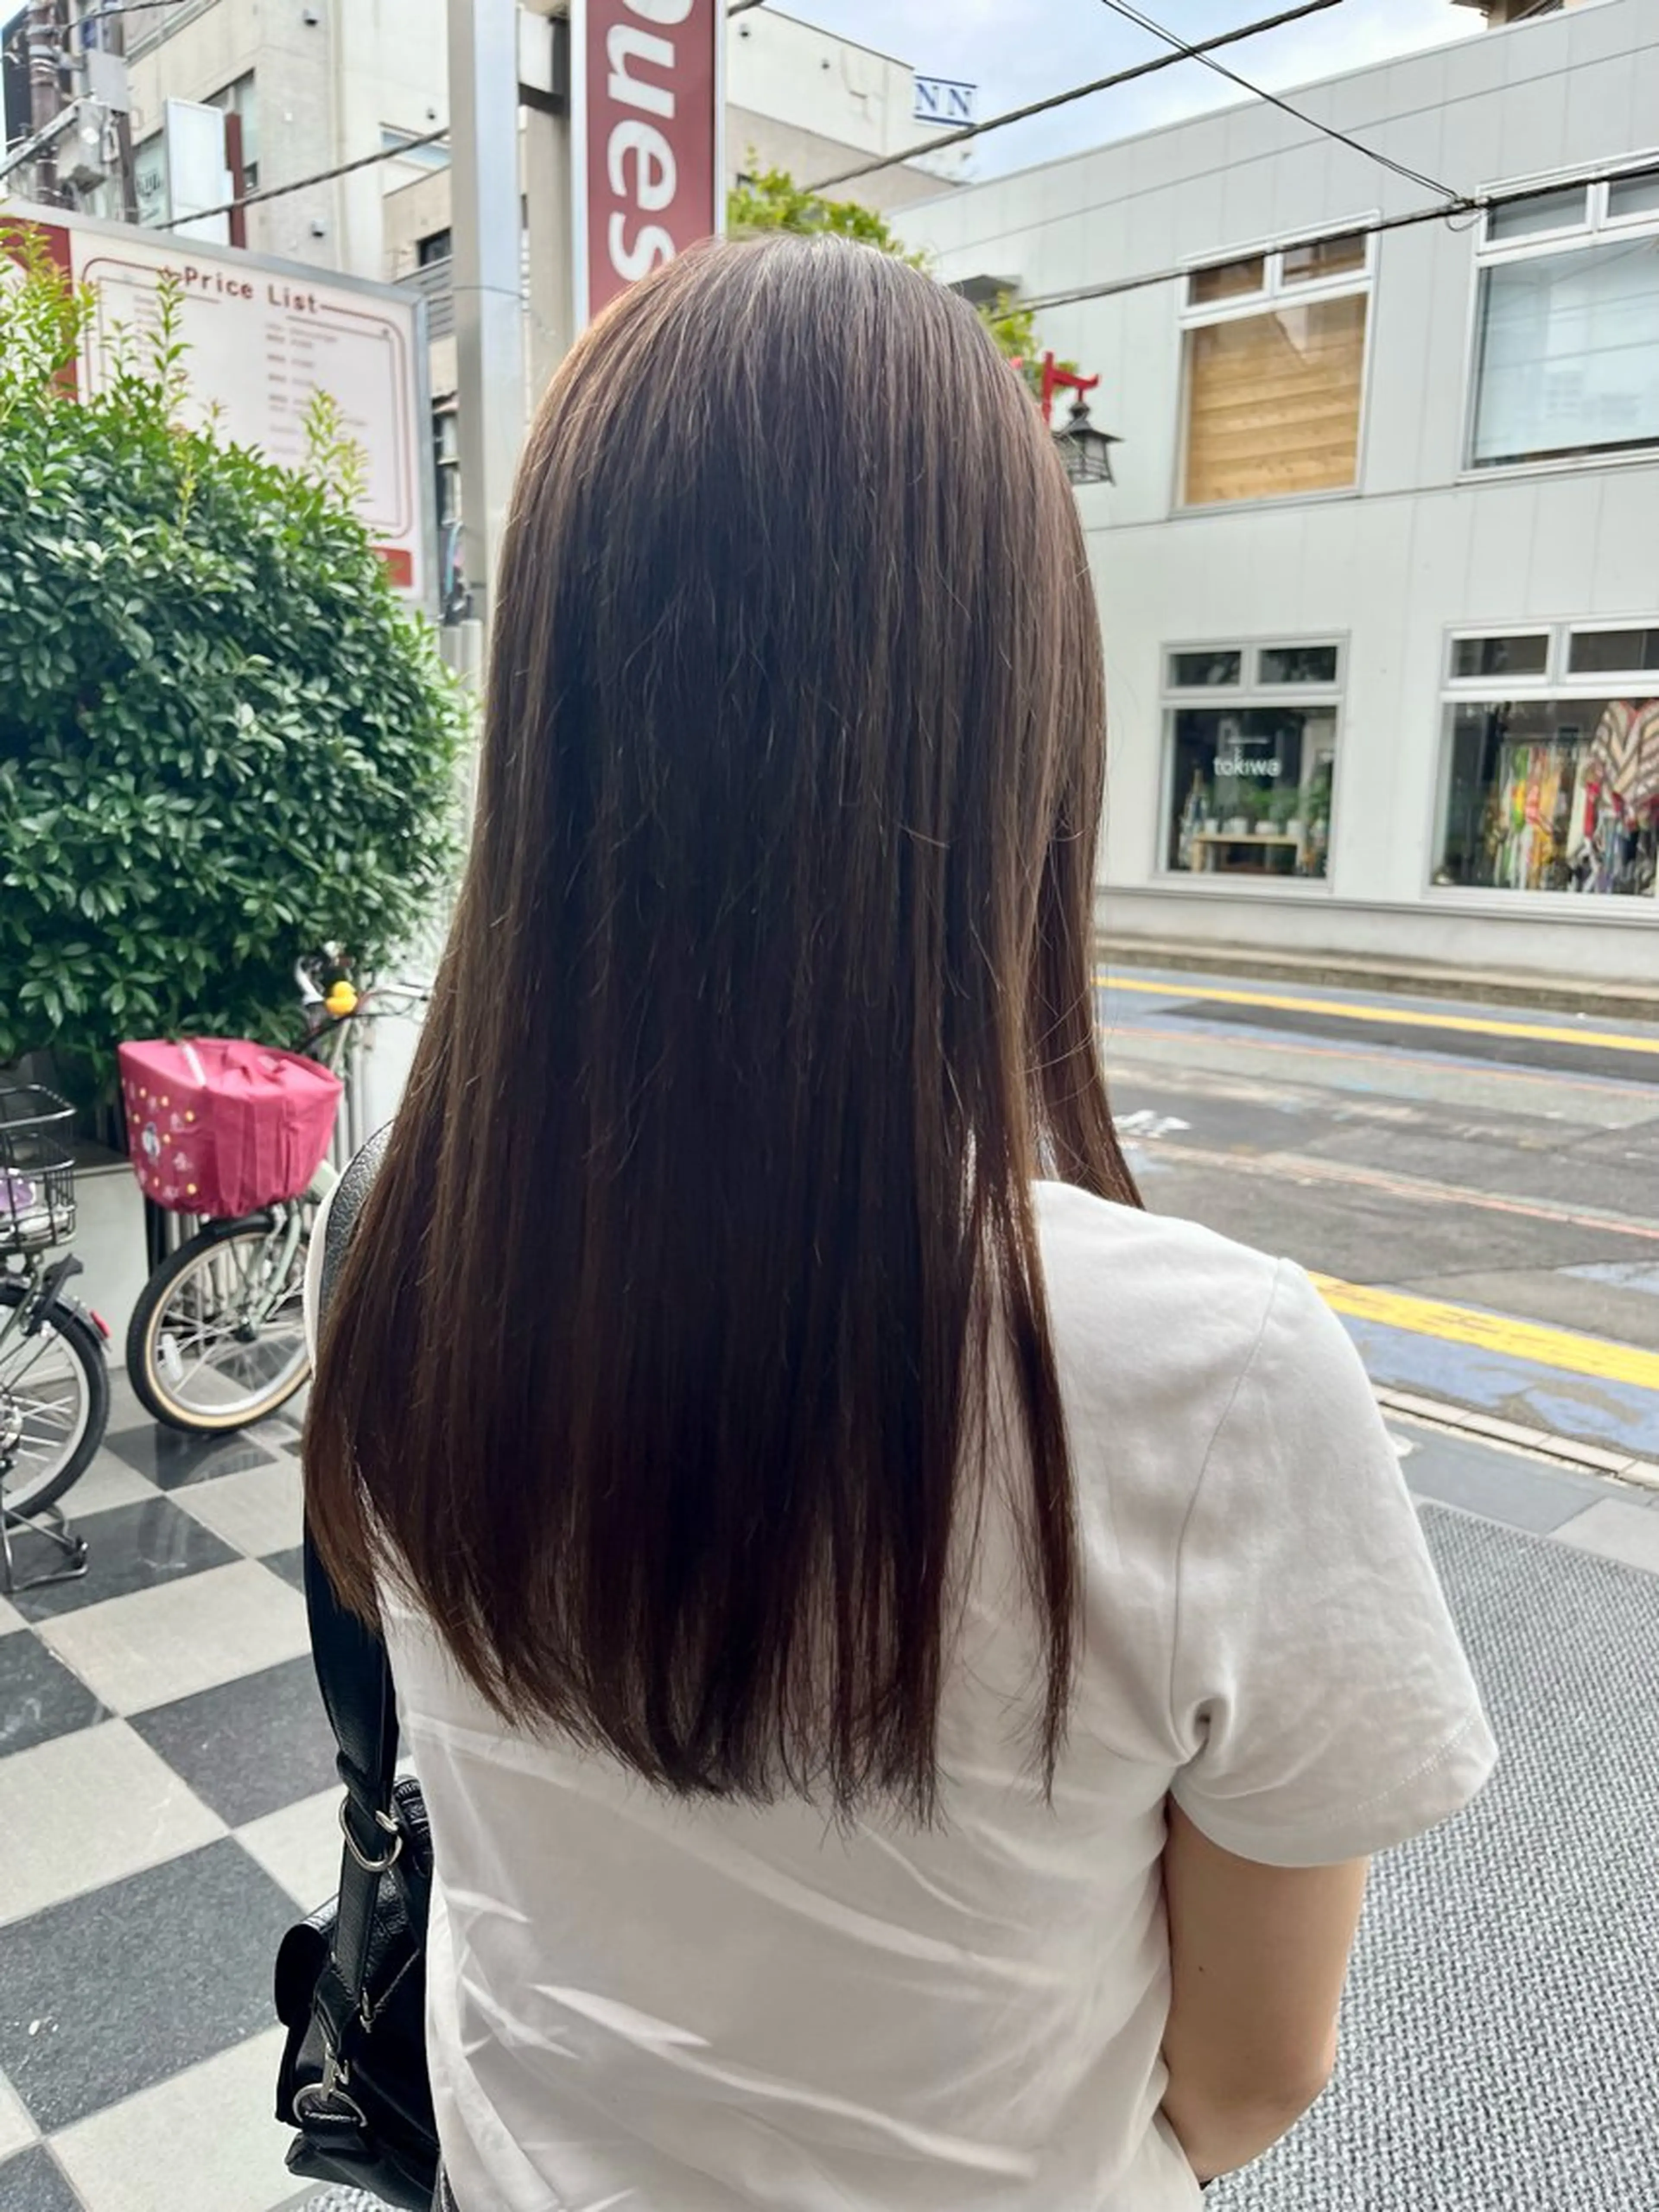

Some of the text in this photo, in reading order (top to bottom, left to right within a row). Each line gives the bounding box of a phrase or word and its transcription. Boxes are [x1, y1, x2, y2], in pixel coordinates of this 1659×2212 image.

[607, 0, 693, 282] ues
[184, 266, 317, 314] Price List
[1213, 747, 1282, 777] tokiwa
